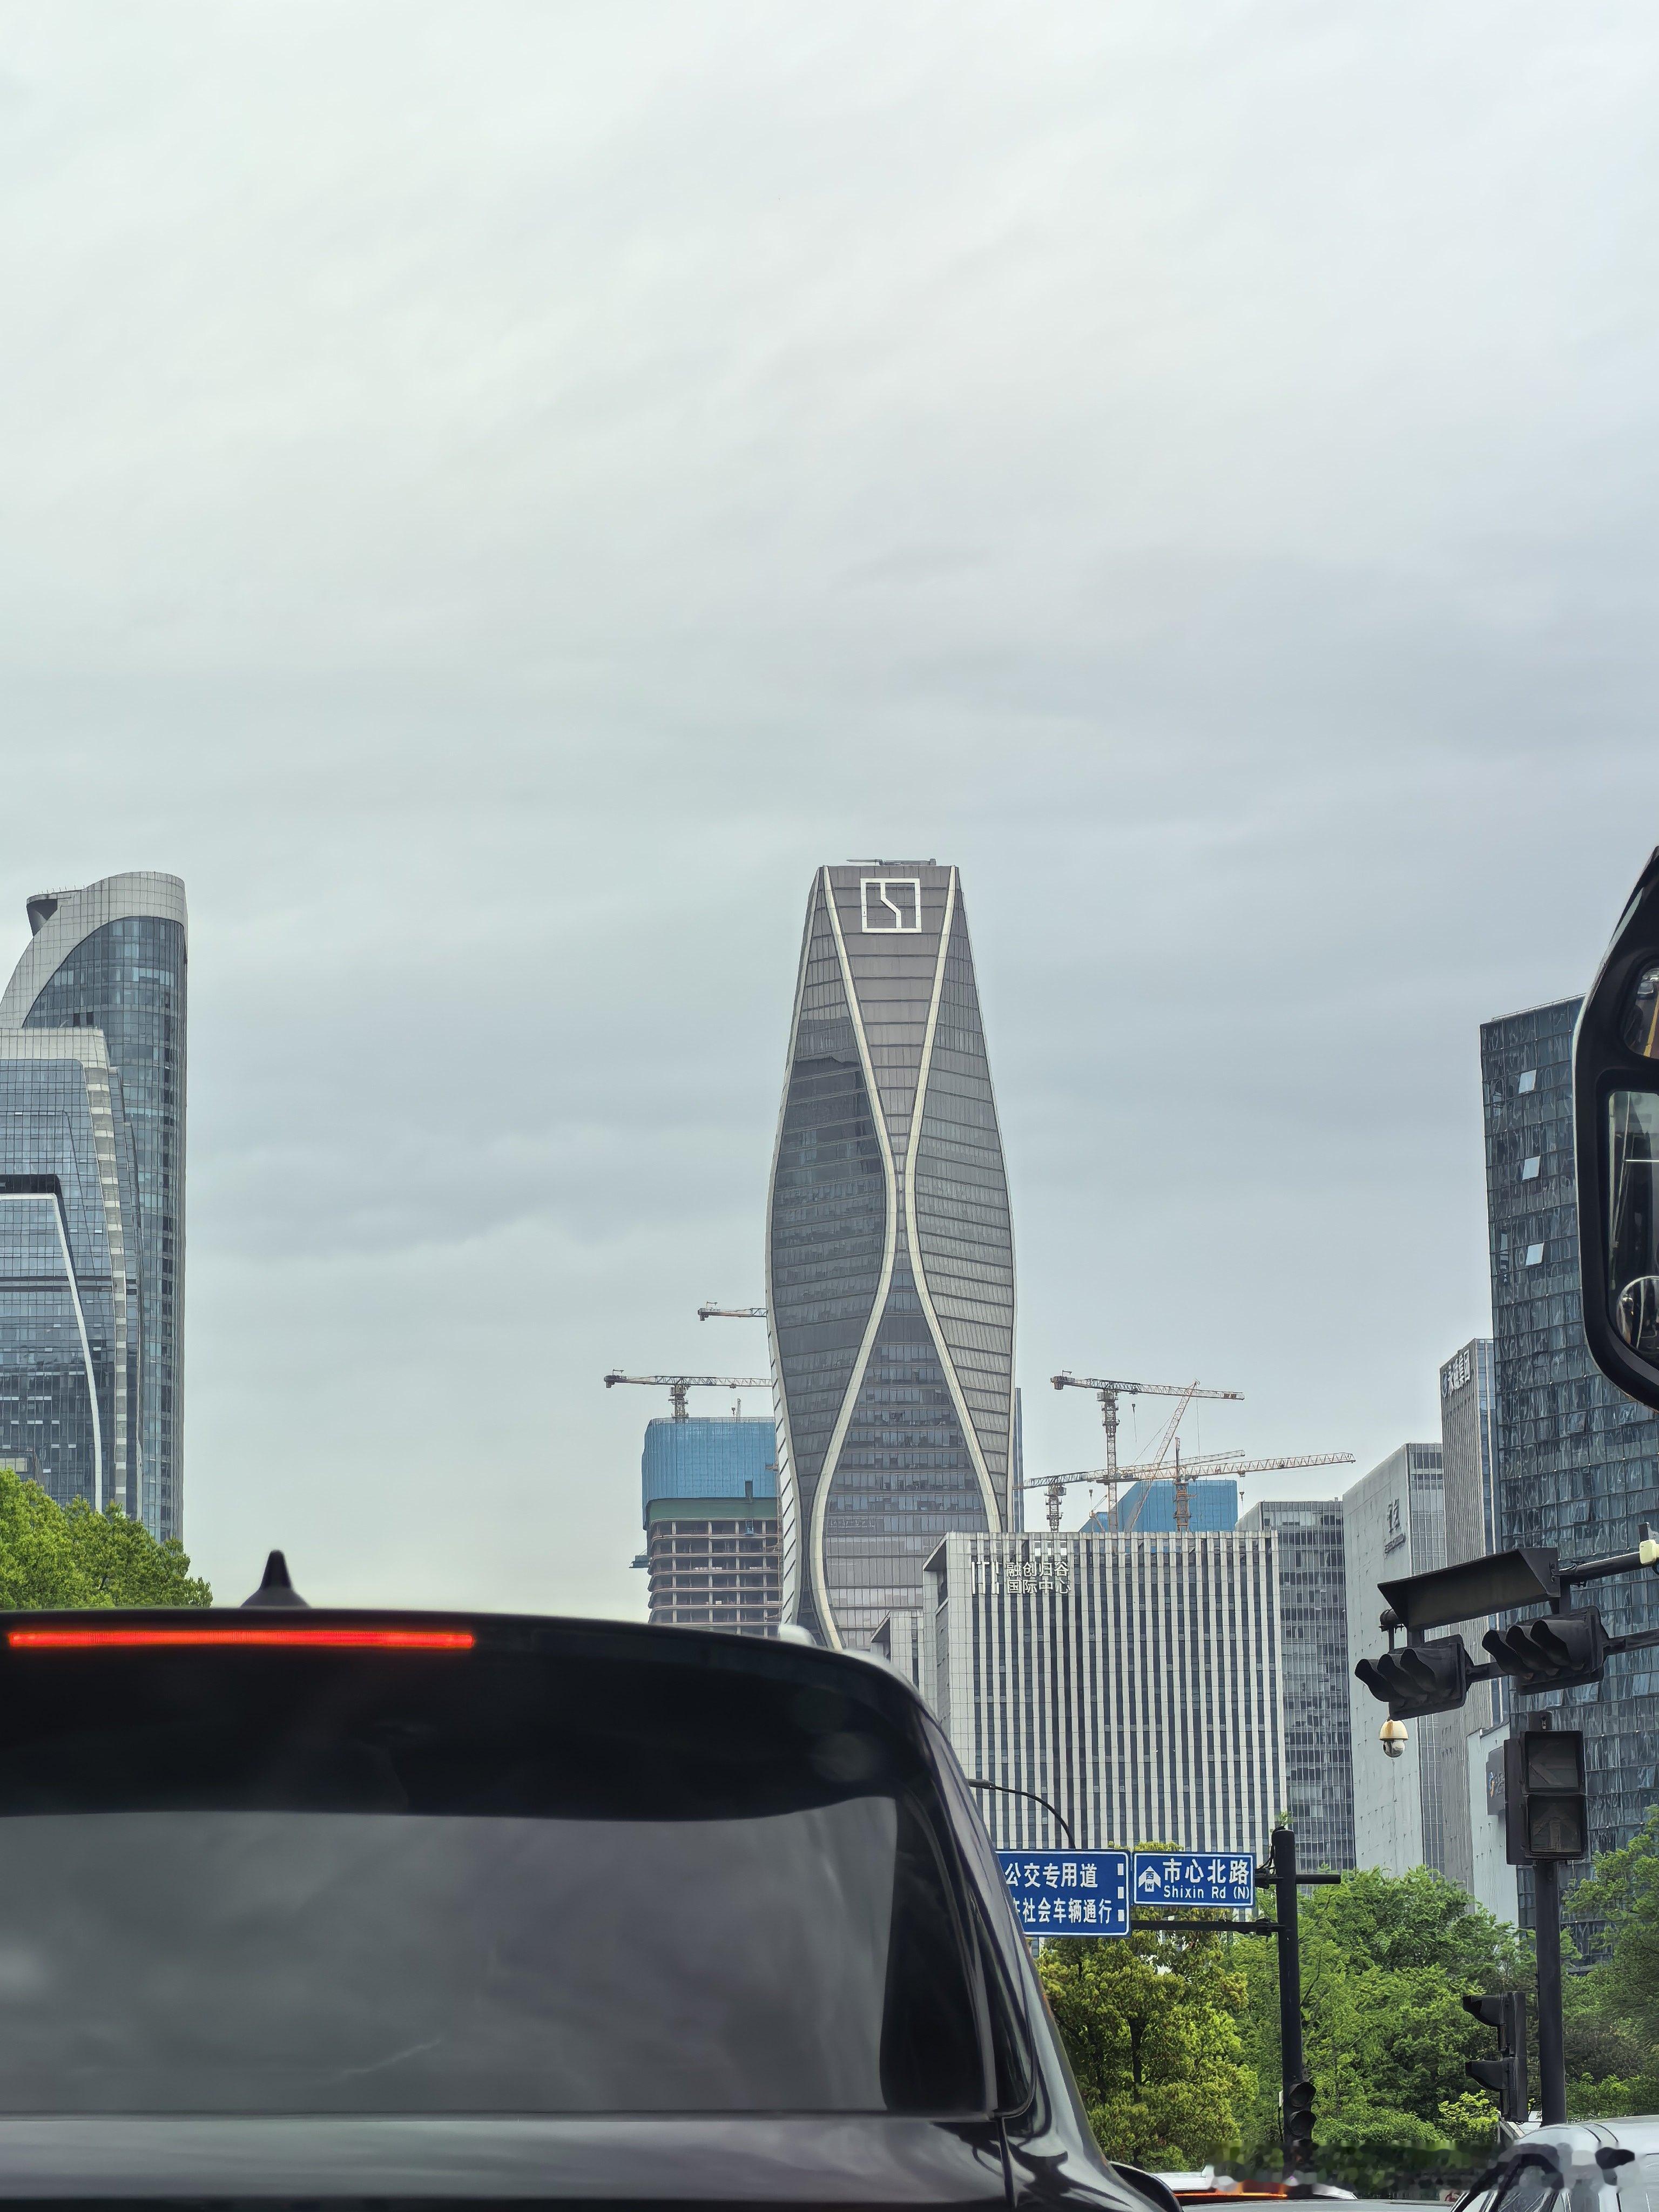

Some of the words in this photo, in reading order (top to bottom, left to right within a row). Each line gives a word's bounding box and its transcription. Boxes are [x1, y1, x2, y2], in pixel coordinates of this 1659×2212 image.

[1006, 1561, 1069, 1577] 融创归谷
[1006, 1579, 1071, 1594] 国际中心
[1004, 1862, 1098, 1889] 公交专用道
[1163, 1858, 1250, 1885] 市心北路
[1163, 1885, 1204, 1899] Shixin
[1211, 1886, 1226, 1899] Rd
[1233, 1886, 1250, 1899] (N)
